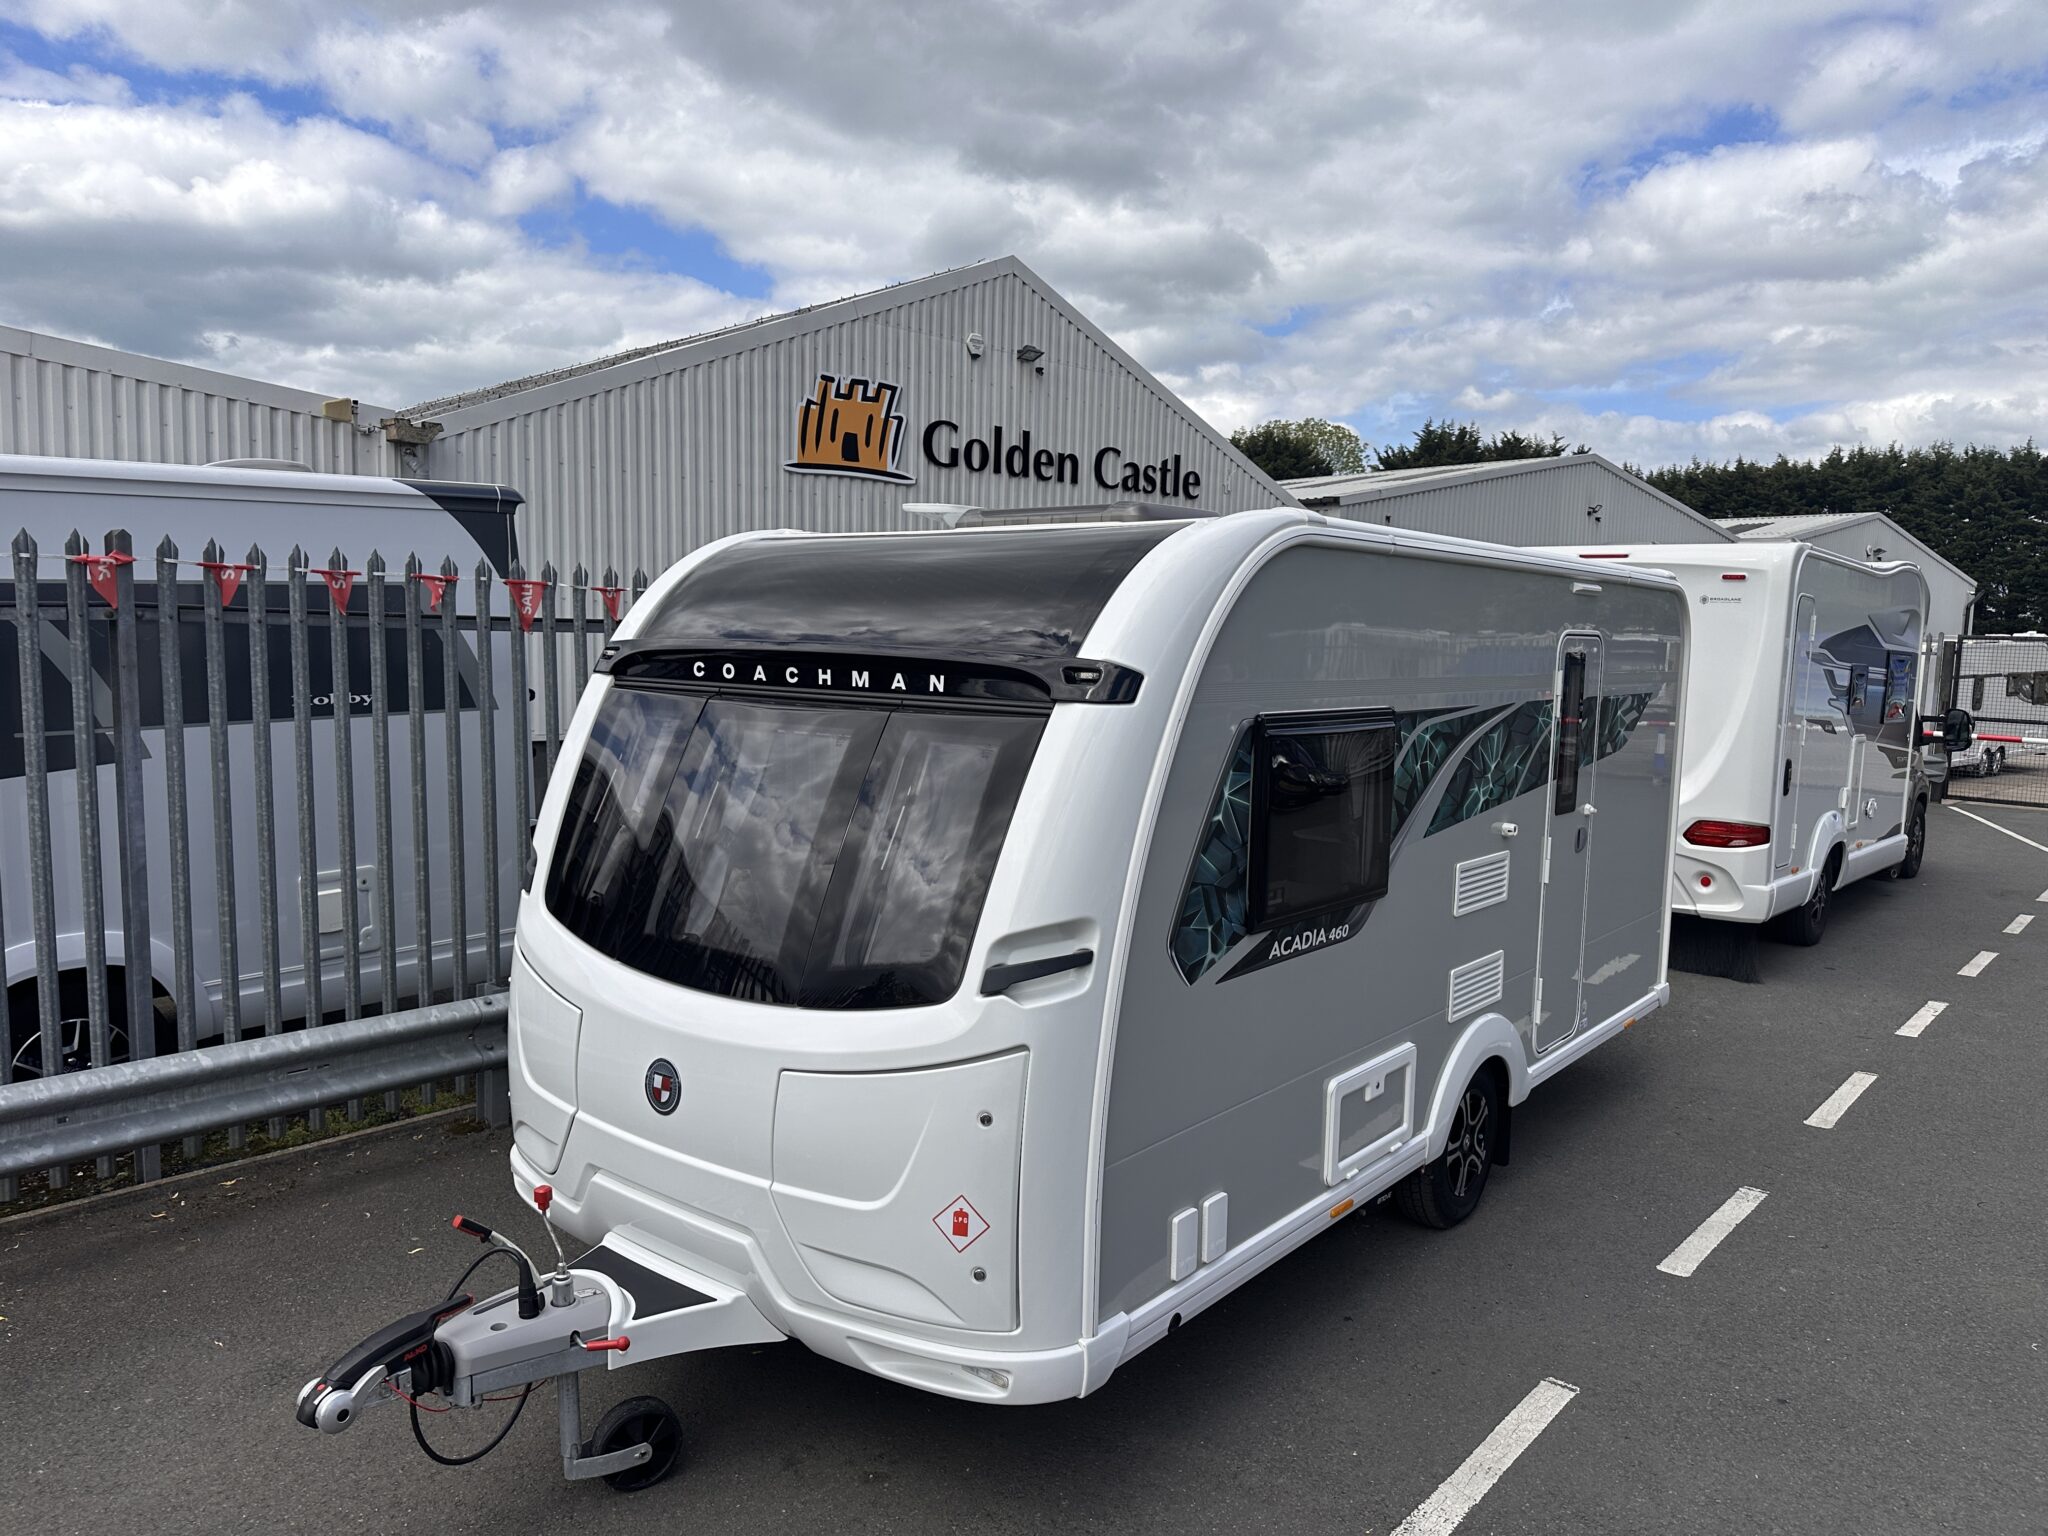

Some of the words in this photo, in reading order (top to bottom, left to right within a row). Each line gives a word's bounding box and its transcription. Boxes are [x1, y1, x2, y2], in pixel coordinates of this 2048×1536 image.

[922, 420, 1079, 485] Golden
[1094, 446, 1201, 500] Castle
[693, 661, 945, 693] COACHMAN
[291, 692, 373, 706] oby
[1268, 927, 1327, 960] ACADIA
[1328, 924, 1349, 941] 460
[953, 1216, 968, 1224] LPG
